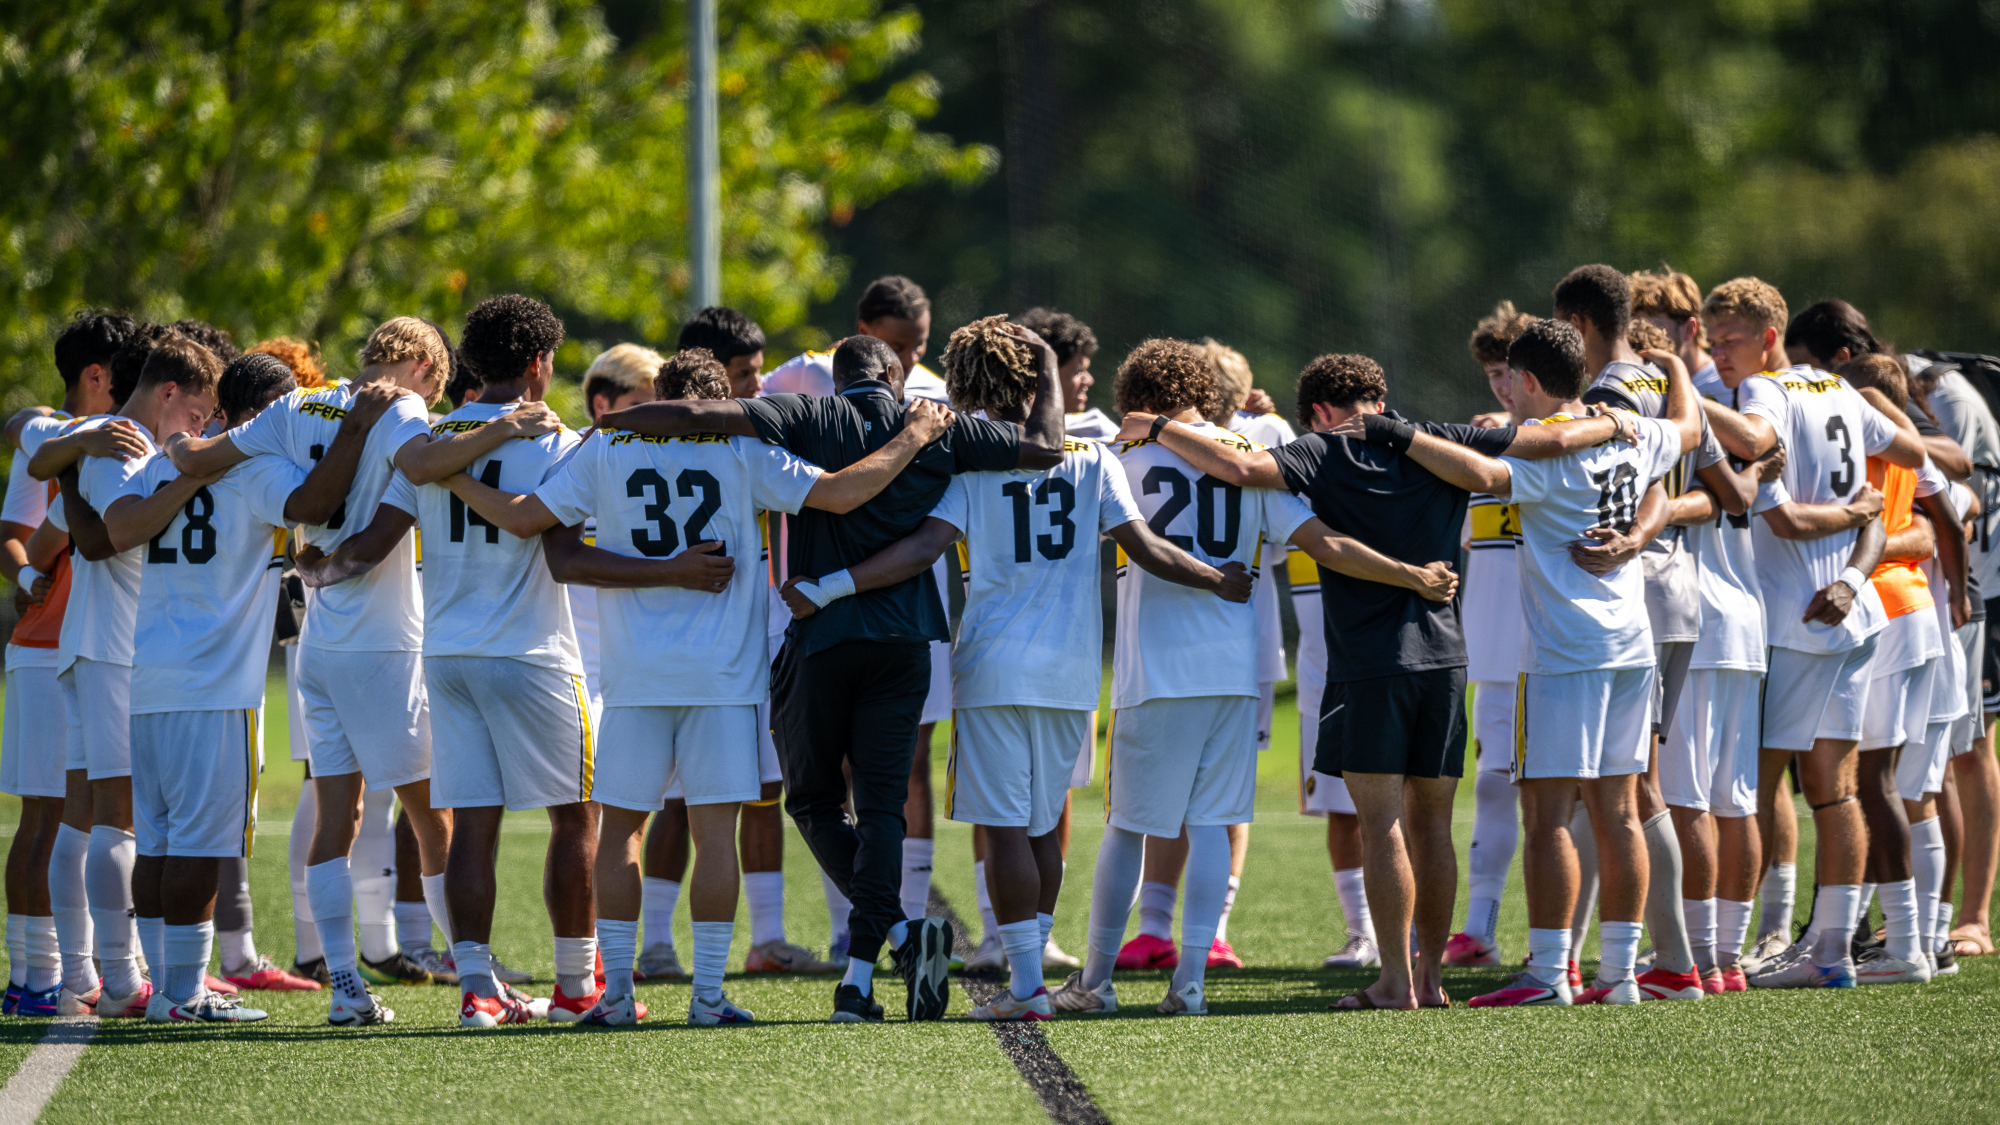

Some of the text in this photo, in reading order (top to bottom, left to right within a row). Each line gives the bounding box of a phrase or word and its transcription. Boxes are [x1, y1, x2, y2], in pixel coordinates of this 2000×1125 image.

[1825, 415, 1855, 498] 3
[147, 480, 217, 564] 28
[450, 459, 502, 544] 14
[626, 468, 726, 557] 32
[1002, 477, 1076, 563] 13
[1142, 466, 1242, 558] 20
